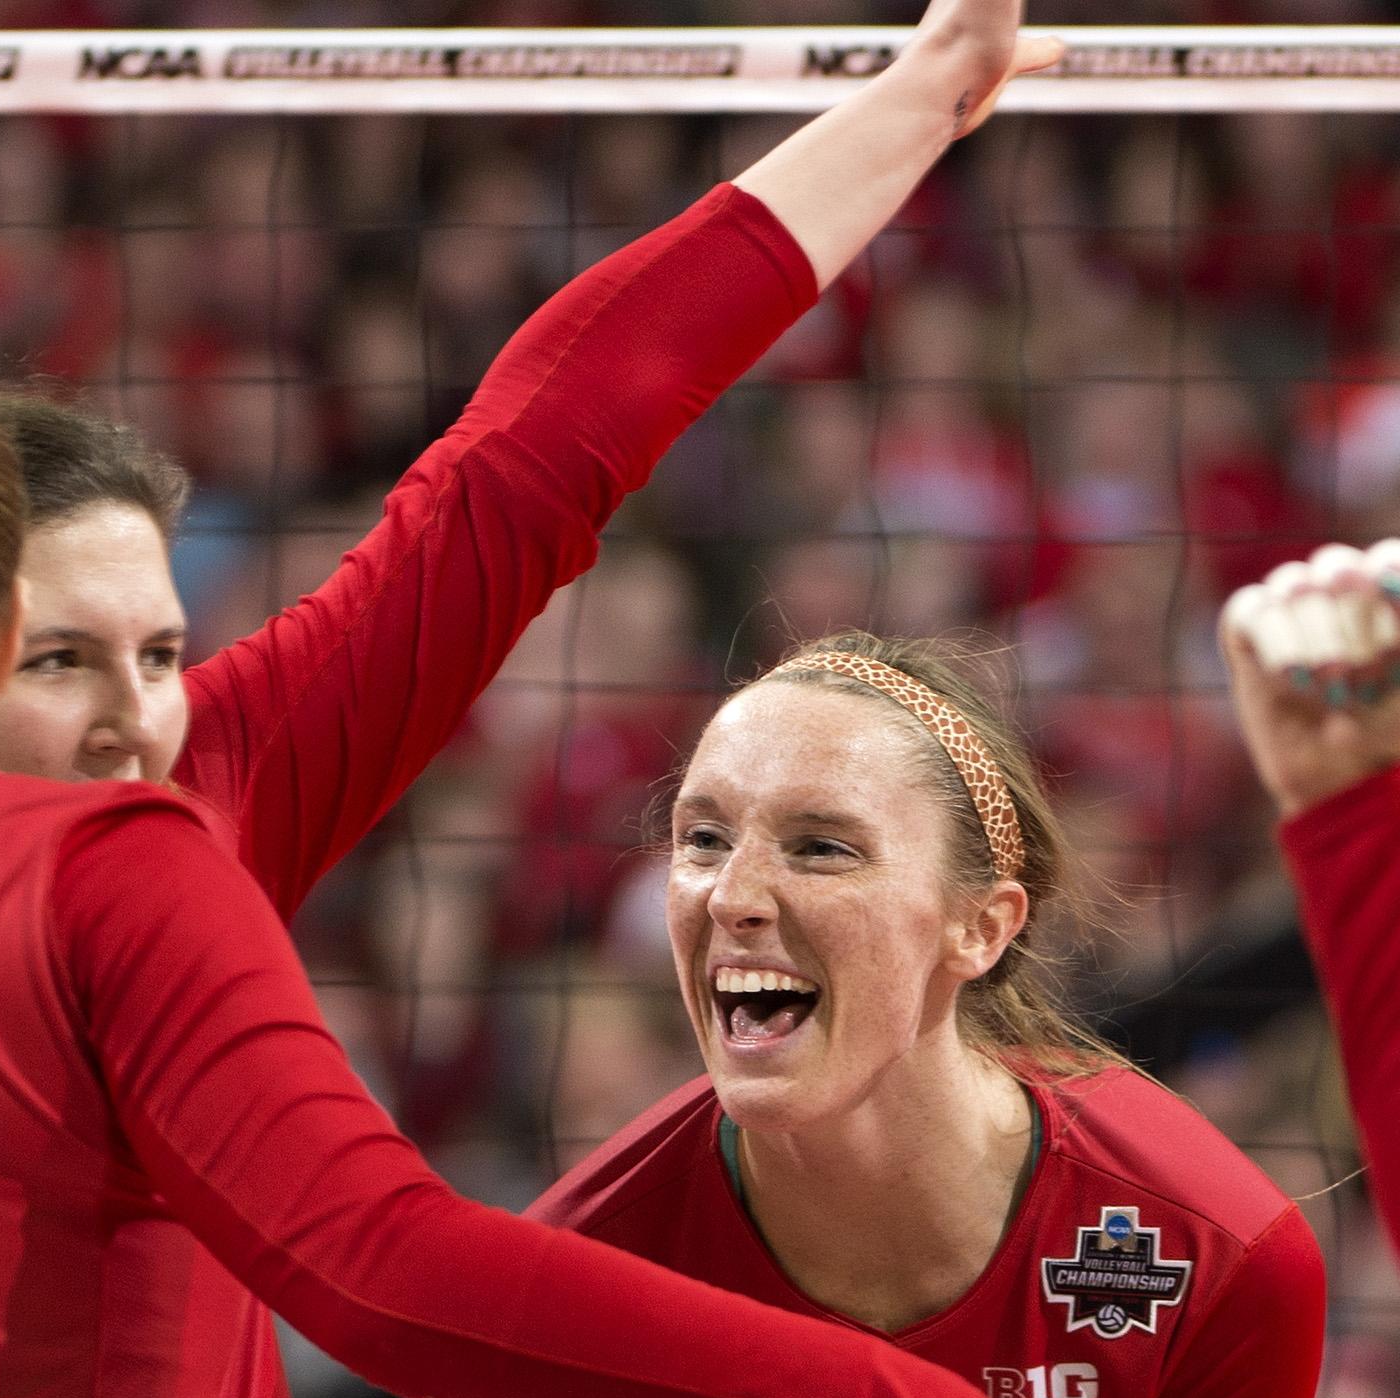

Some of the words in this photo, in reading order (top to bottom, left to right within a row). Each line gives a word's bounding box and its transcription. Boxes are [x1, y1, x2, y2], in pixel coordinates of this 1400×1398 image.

[79, 47, 202, 80] NCAA
[1084, 1258, 1147, 1273] VOLLEYBALL
[1056, 1269, 1177, 1292] CHAMPIONSHIP
